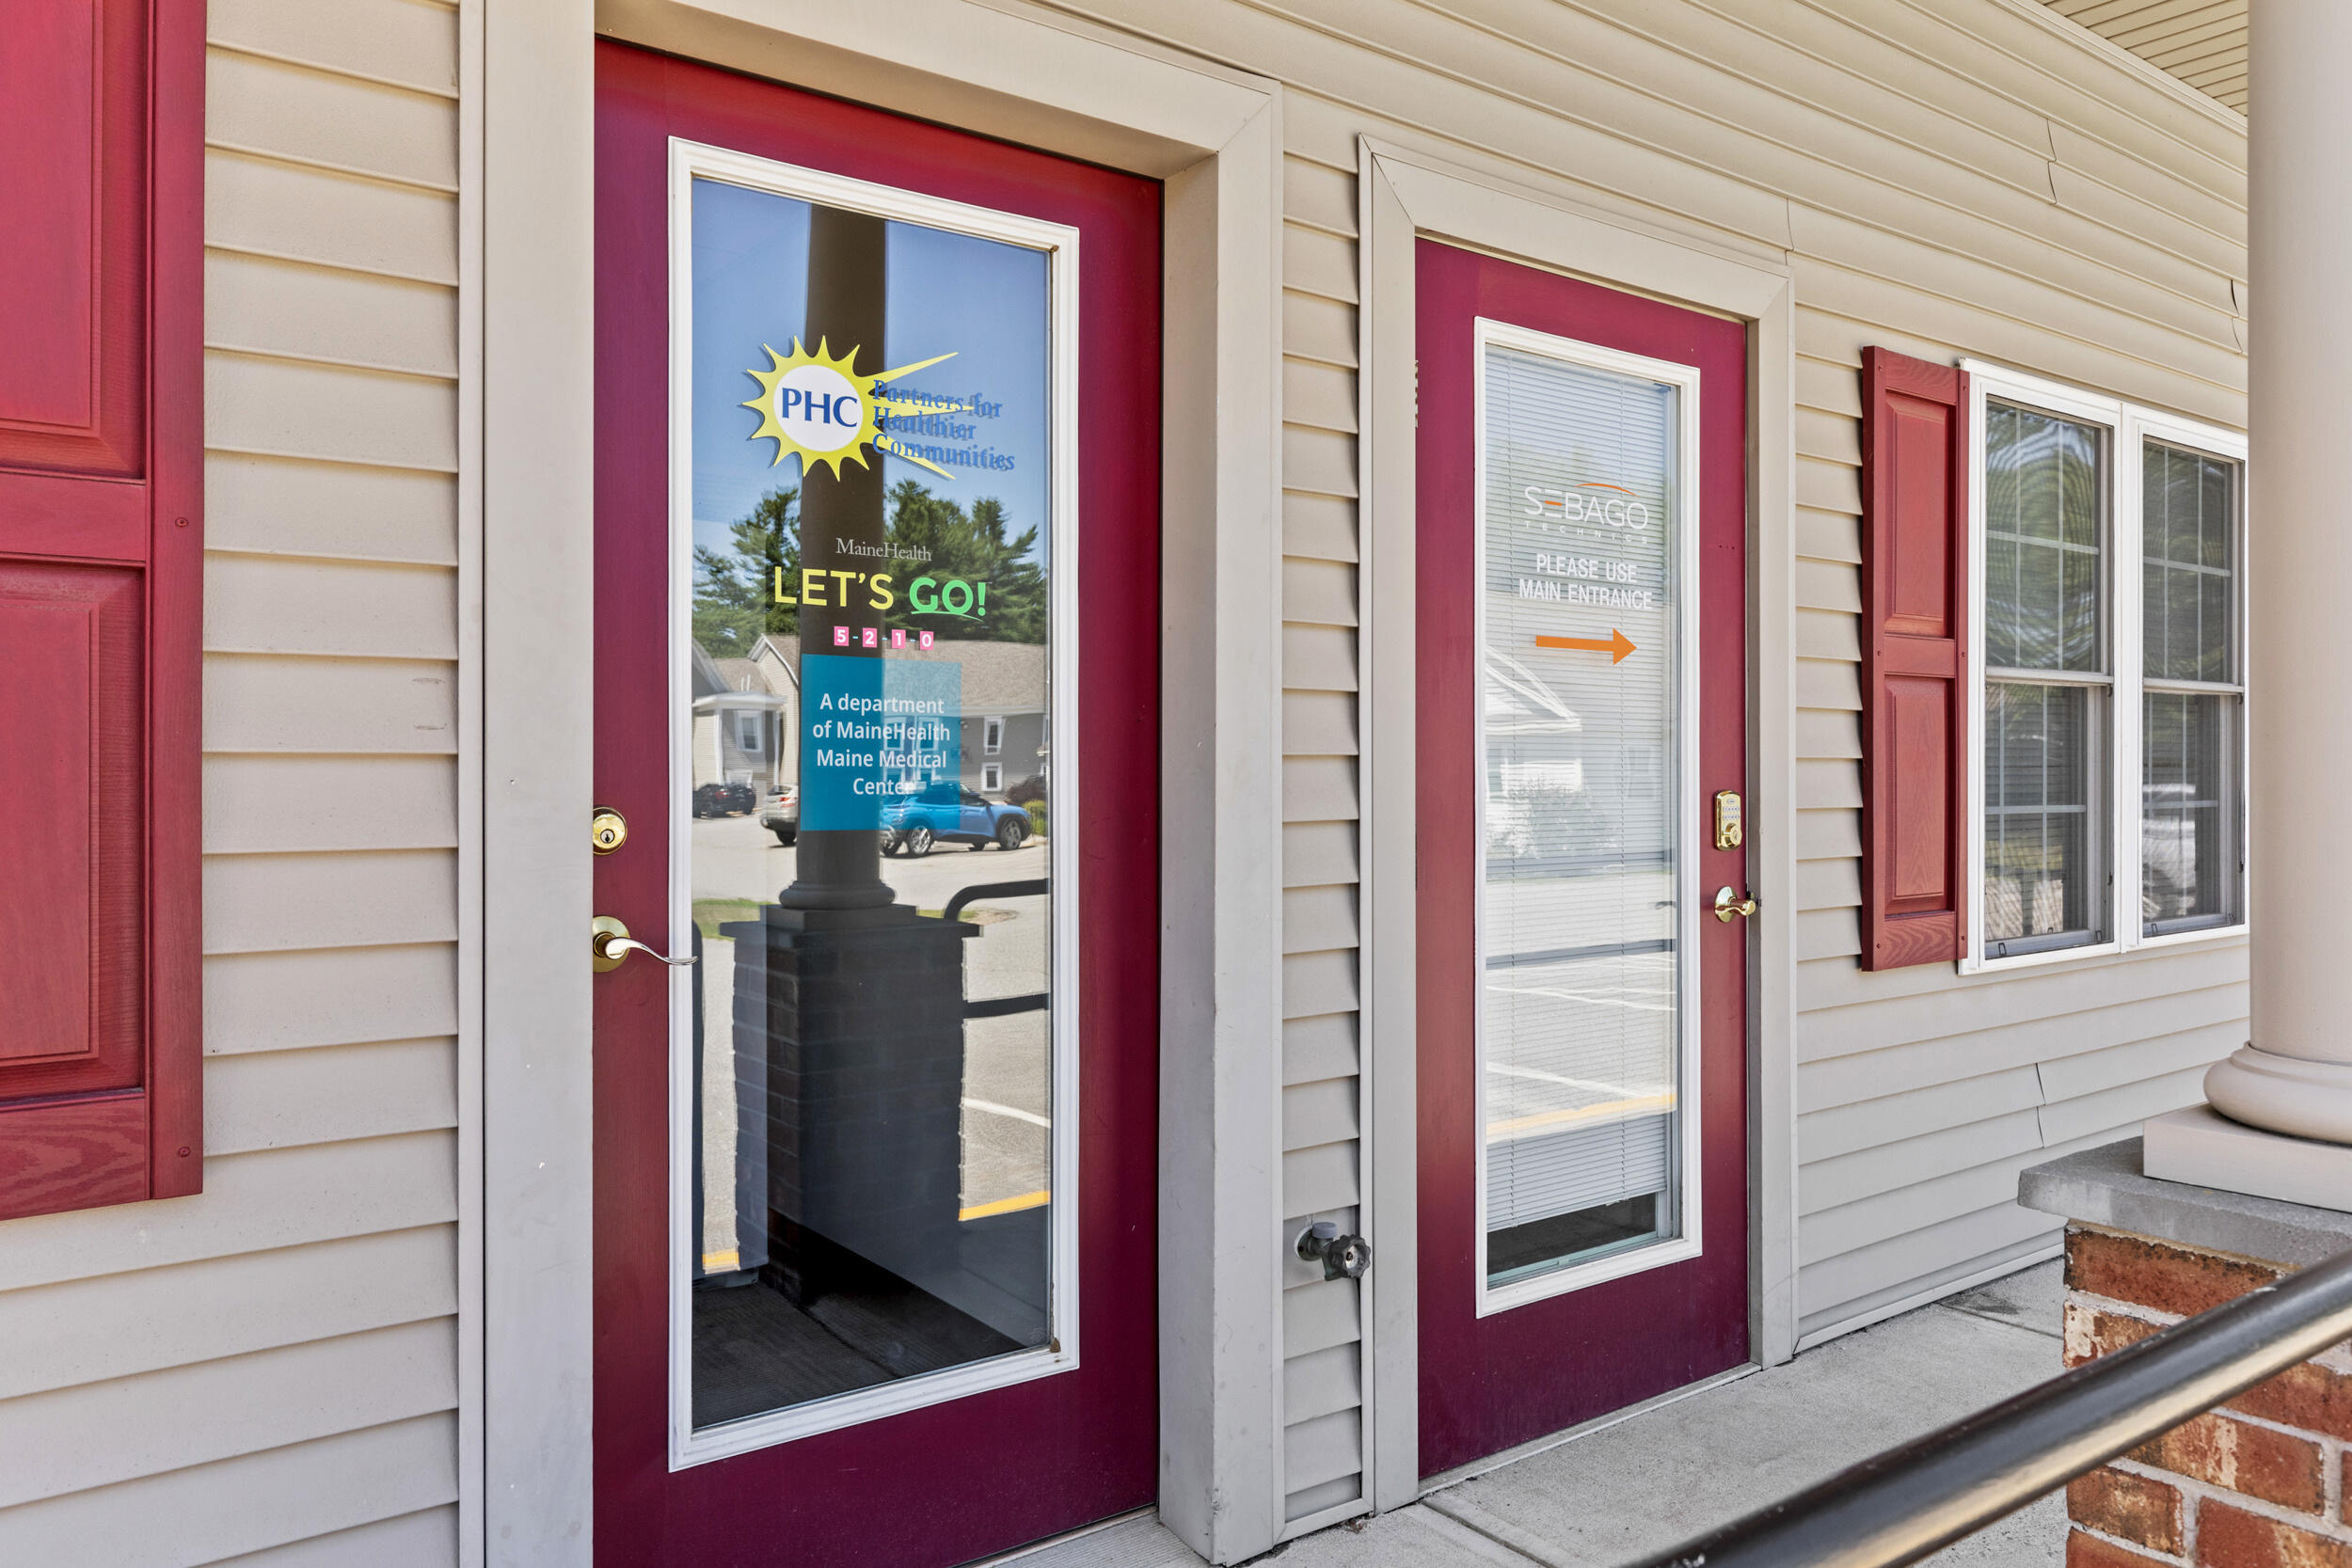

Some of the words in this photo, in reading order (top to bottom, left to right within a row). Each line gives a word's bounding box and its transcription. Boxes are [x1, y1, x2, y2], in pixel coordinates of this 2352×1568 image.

[782, 388, 858, 427] PHC
[872, 379, 964, 411] Partners
[973, 392, 1004, 418] for
[873, 406, 977, 439] Healthier
[872, 434, 1016, 470] Communities
[1524, 485, 1648, 530] SEBAGO
[835, 537, 932, 562] MaineHealth
[1536, 553, 1599, 579] PLEASE
[1606, 562, 1638, 584] USE
[774, 566, 895, 610] LET'S
[909, 577, 987, 616] GO!
[1518, 578, 1561, 602] MAIN
[1568, 584, 1653, 610] ENTRANCE
[819, 693, 834, 710] A
[837, 693, 945, 716] department
[812, 721, 833, 738] of
[836, 721, 950, 741] MaineHealth
[817, 749, 874, 768] Maine
[879, 751, 946, 768] Medical
